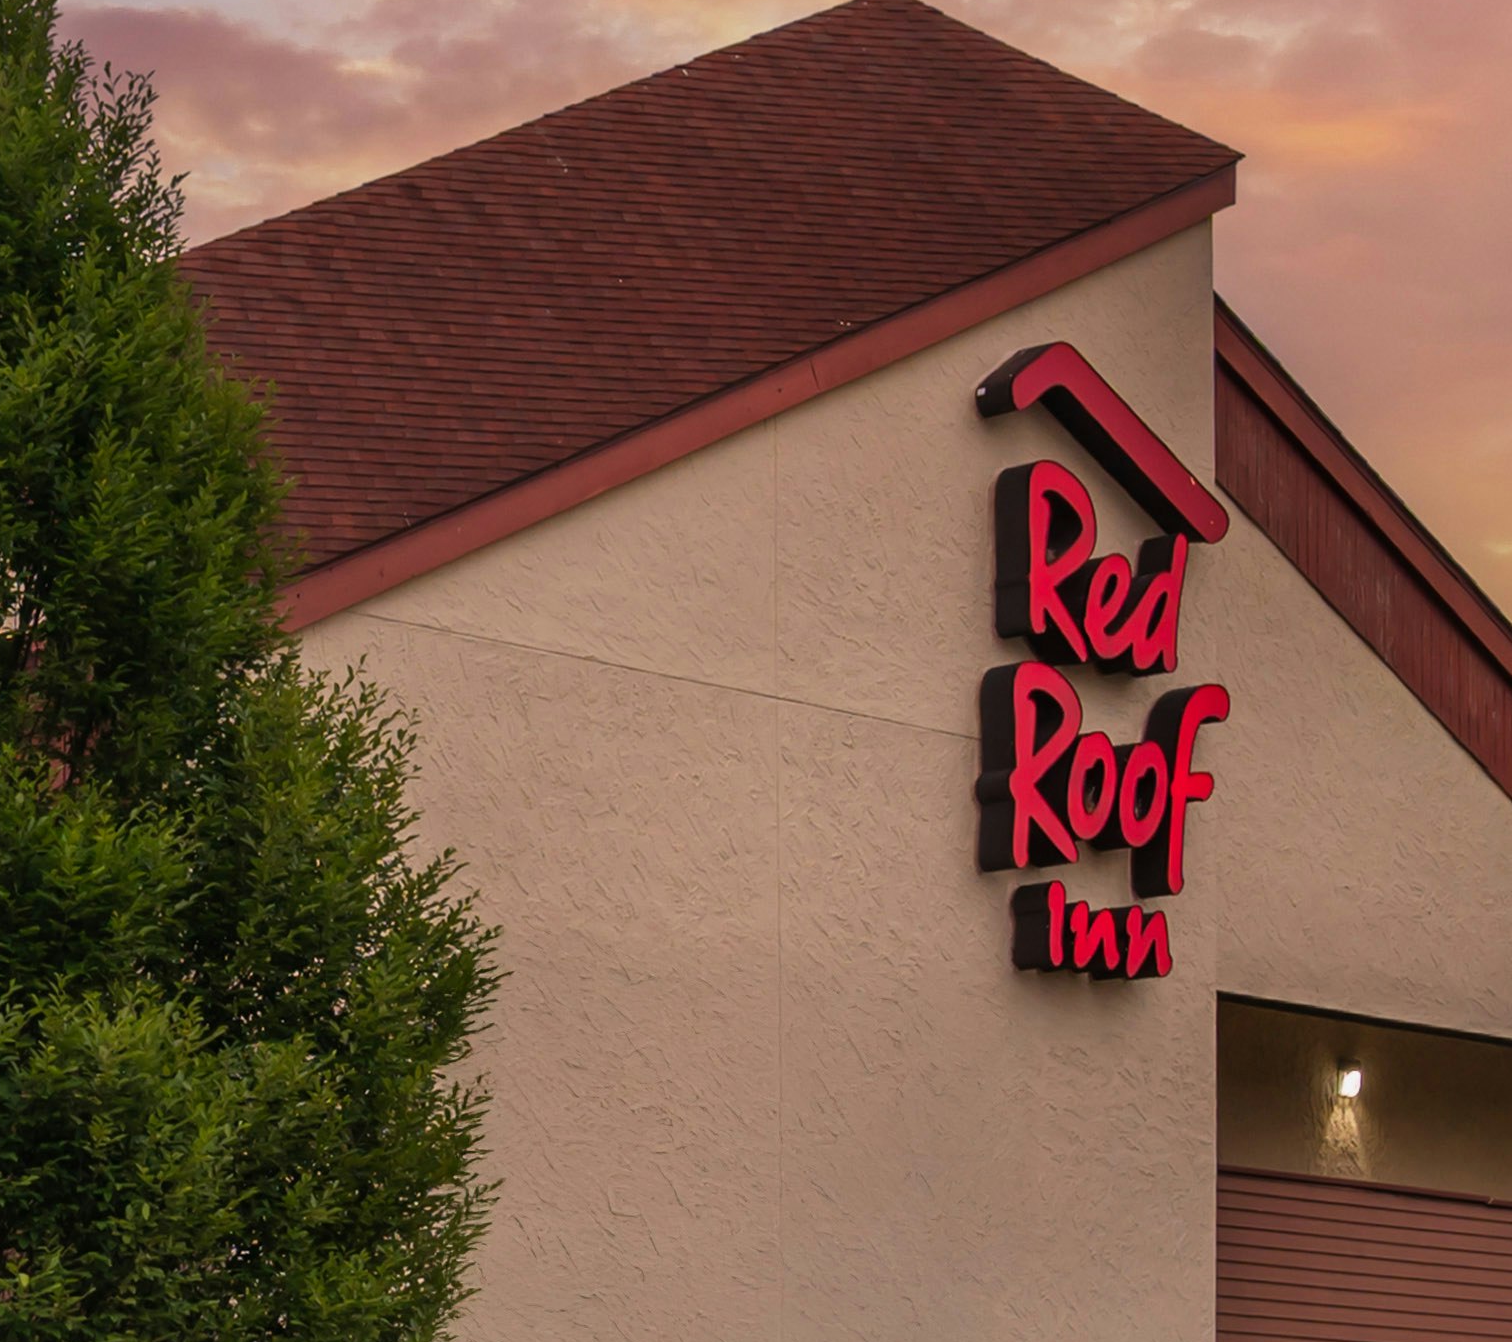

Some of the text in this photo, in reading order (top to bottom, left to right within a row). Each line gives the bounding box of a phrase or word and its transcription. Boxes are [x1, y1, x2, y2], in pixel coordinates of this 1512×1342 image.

[1028, 460, 1187, 673] Red
[1009, 660, 1230, 896] Roof
[1047, 881, 1172, 977] Inn
